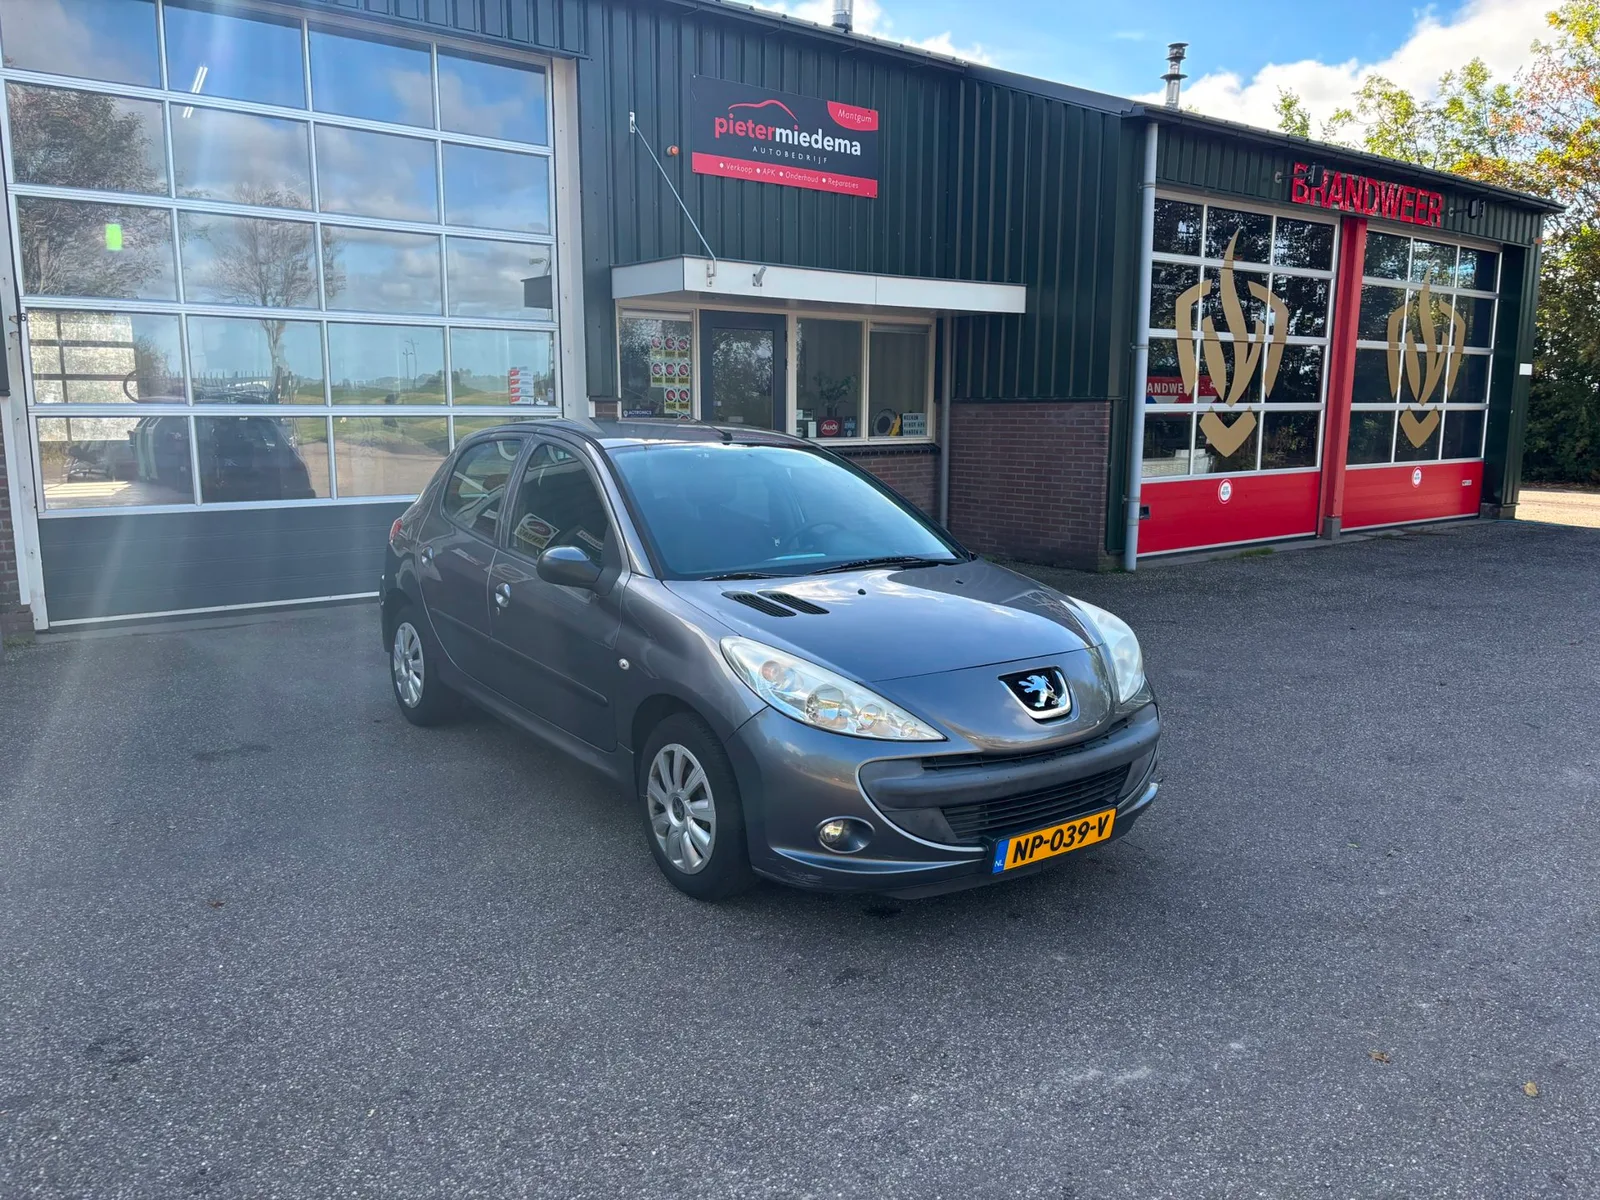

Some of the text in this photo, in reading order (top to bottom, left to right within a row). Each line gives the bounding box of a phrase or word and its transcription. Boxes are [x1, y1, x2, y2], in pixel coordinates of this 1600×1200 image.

[837, 109, 872, 123] Mantgum
[752, 146, 828, 165] AUTOBEDRIJF
[725, 162, 859, 189] Verkoop APK Onderhoud Reparaties
[1291, 162, 1443, 228] BRANDWEER
[1147, 382, 1184, 393] ANDWE
[1012, 814, 1110, 864] NP-039-V
